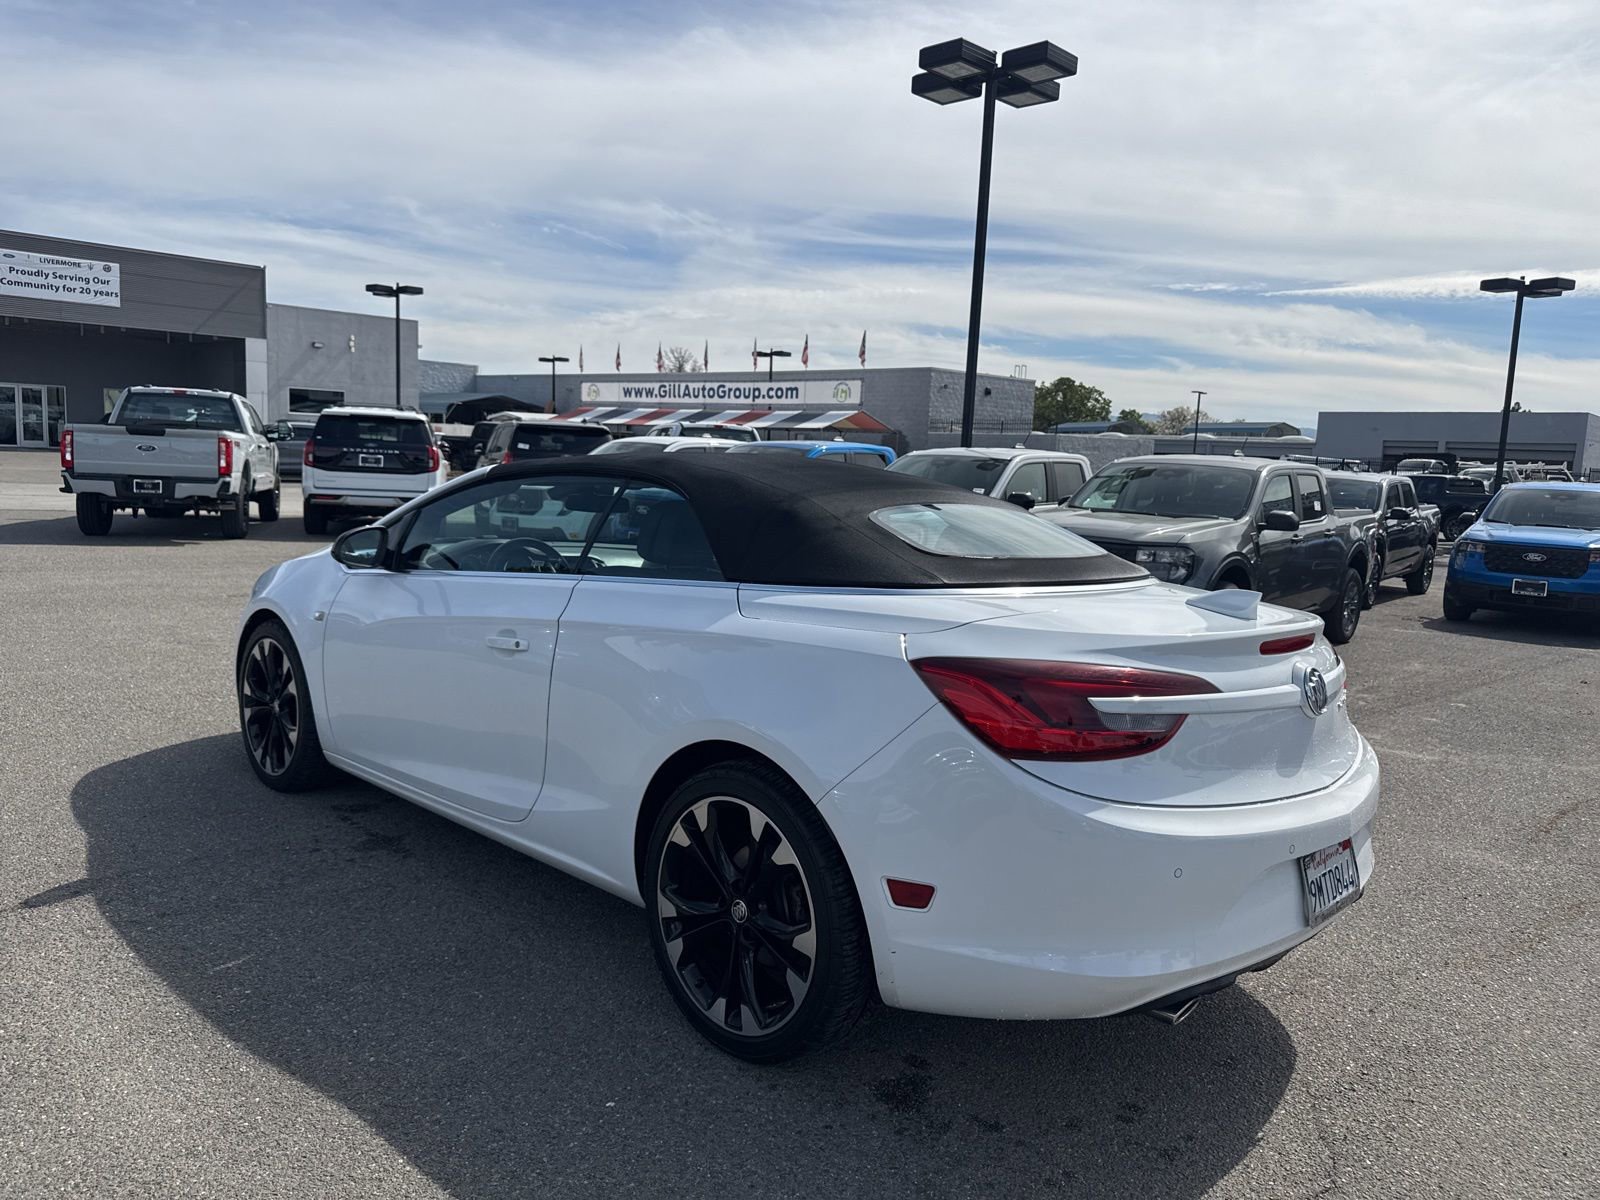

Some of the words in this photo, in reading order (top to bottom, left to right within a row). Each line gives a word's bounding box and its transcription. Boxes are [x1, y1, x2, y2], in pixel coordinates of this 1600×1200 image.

[39, 257, 82, 268] LIVERMORE
[8, 266, 50, 280] Proudly
[52, 271, 91, 285] Serving
[92, 276, 111, 286] Our
[0, 277, 60, 293] Community
[62, 284, 77, 293] for
[79, 286, 91, 295] 20
[93, 289, 119, 297] years
[622, 383, 799, 402] www.GillAutoGroup.com
[1311, 846, 1342, 870] California
[1309, 858, 1355, 913] 9MTD844
